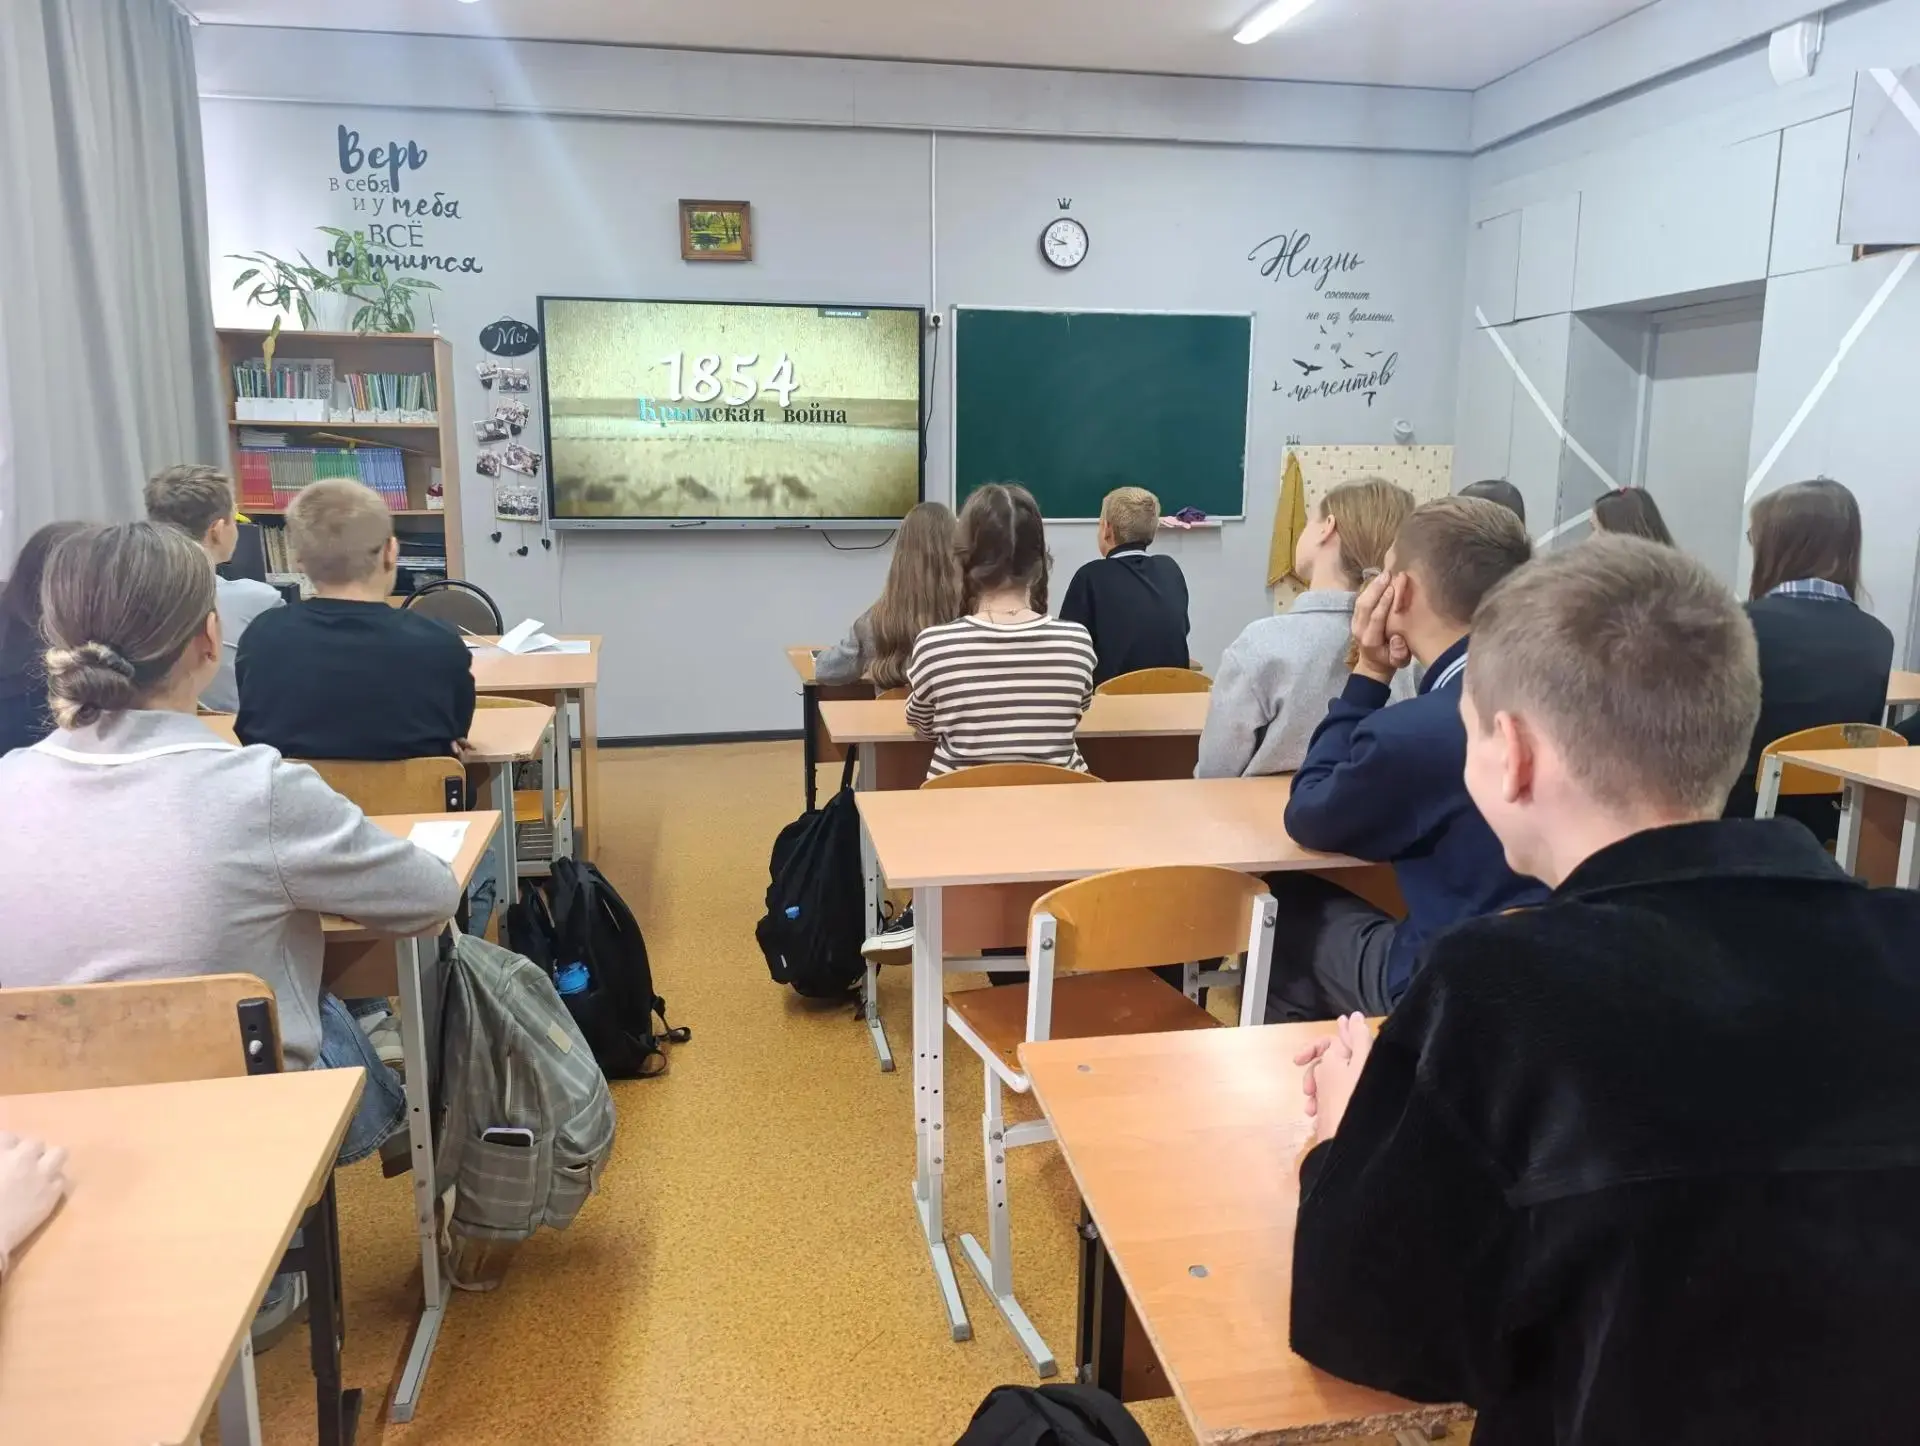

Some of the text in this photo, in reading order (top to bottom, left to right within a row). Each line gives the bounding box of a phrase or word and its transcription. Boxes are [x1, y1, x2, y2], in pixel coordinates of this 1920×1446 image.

[338, 124, 428, 193] Верь
[352, 191, 461, 219] и у тебя
[368, 220, 424, 248] ВСЁ
[327, 250, 483, 283] поучится
[1247, 228, 1365, 291] Жизнь
[1324, 290, 1370, 301] состоит
[1306, 311, 1320, 321] не
[1326, 311, 1340, 325] из
[491, 325, 529, 352] Мы
[659, 350, 801, 408] 1854
[1287, 351, 1399, 403] моментов
[637, 396, 847, 428] Крымская война
